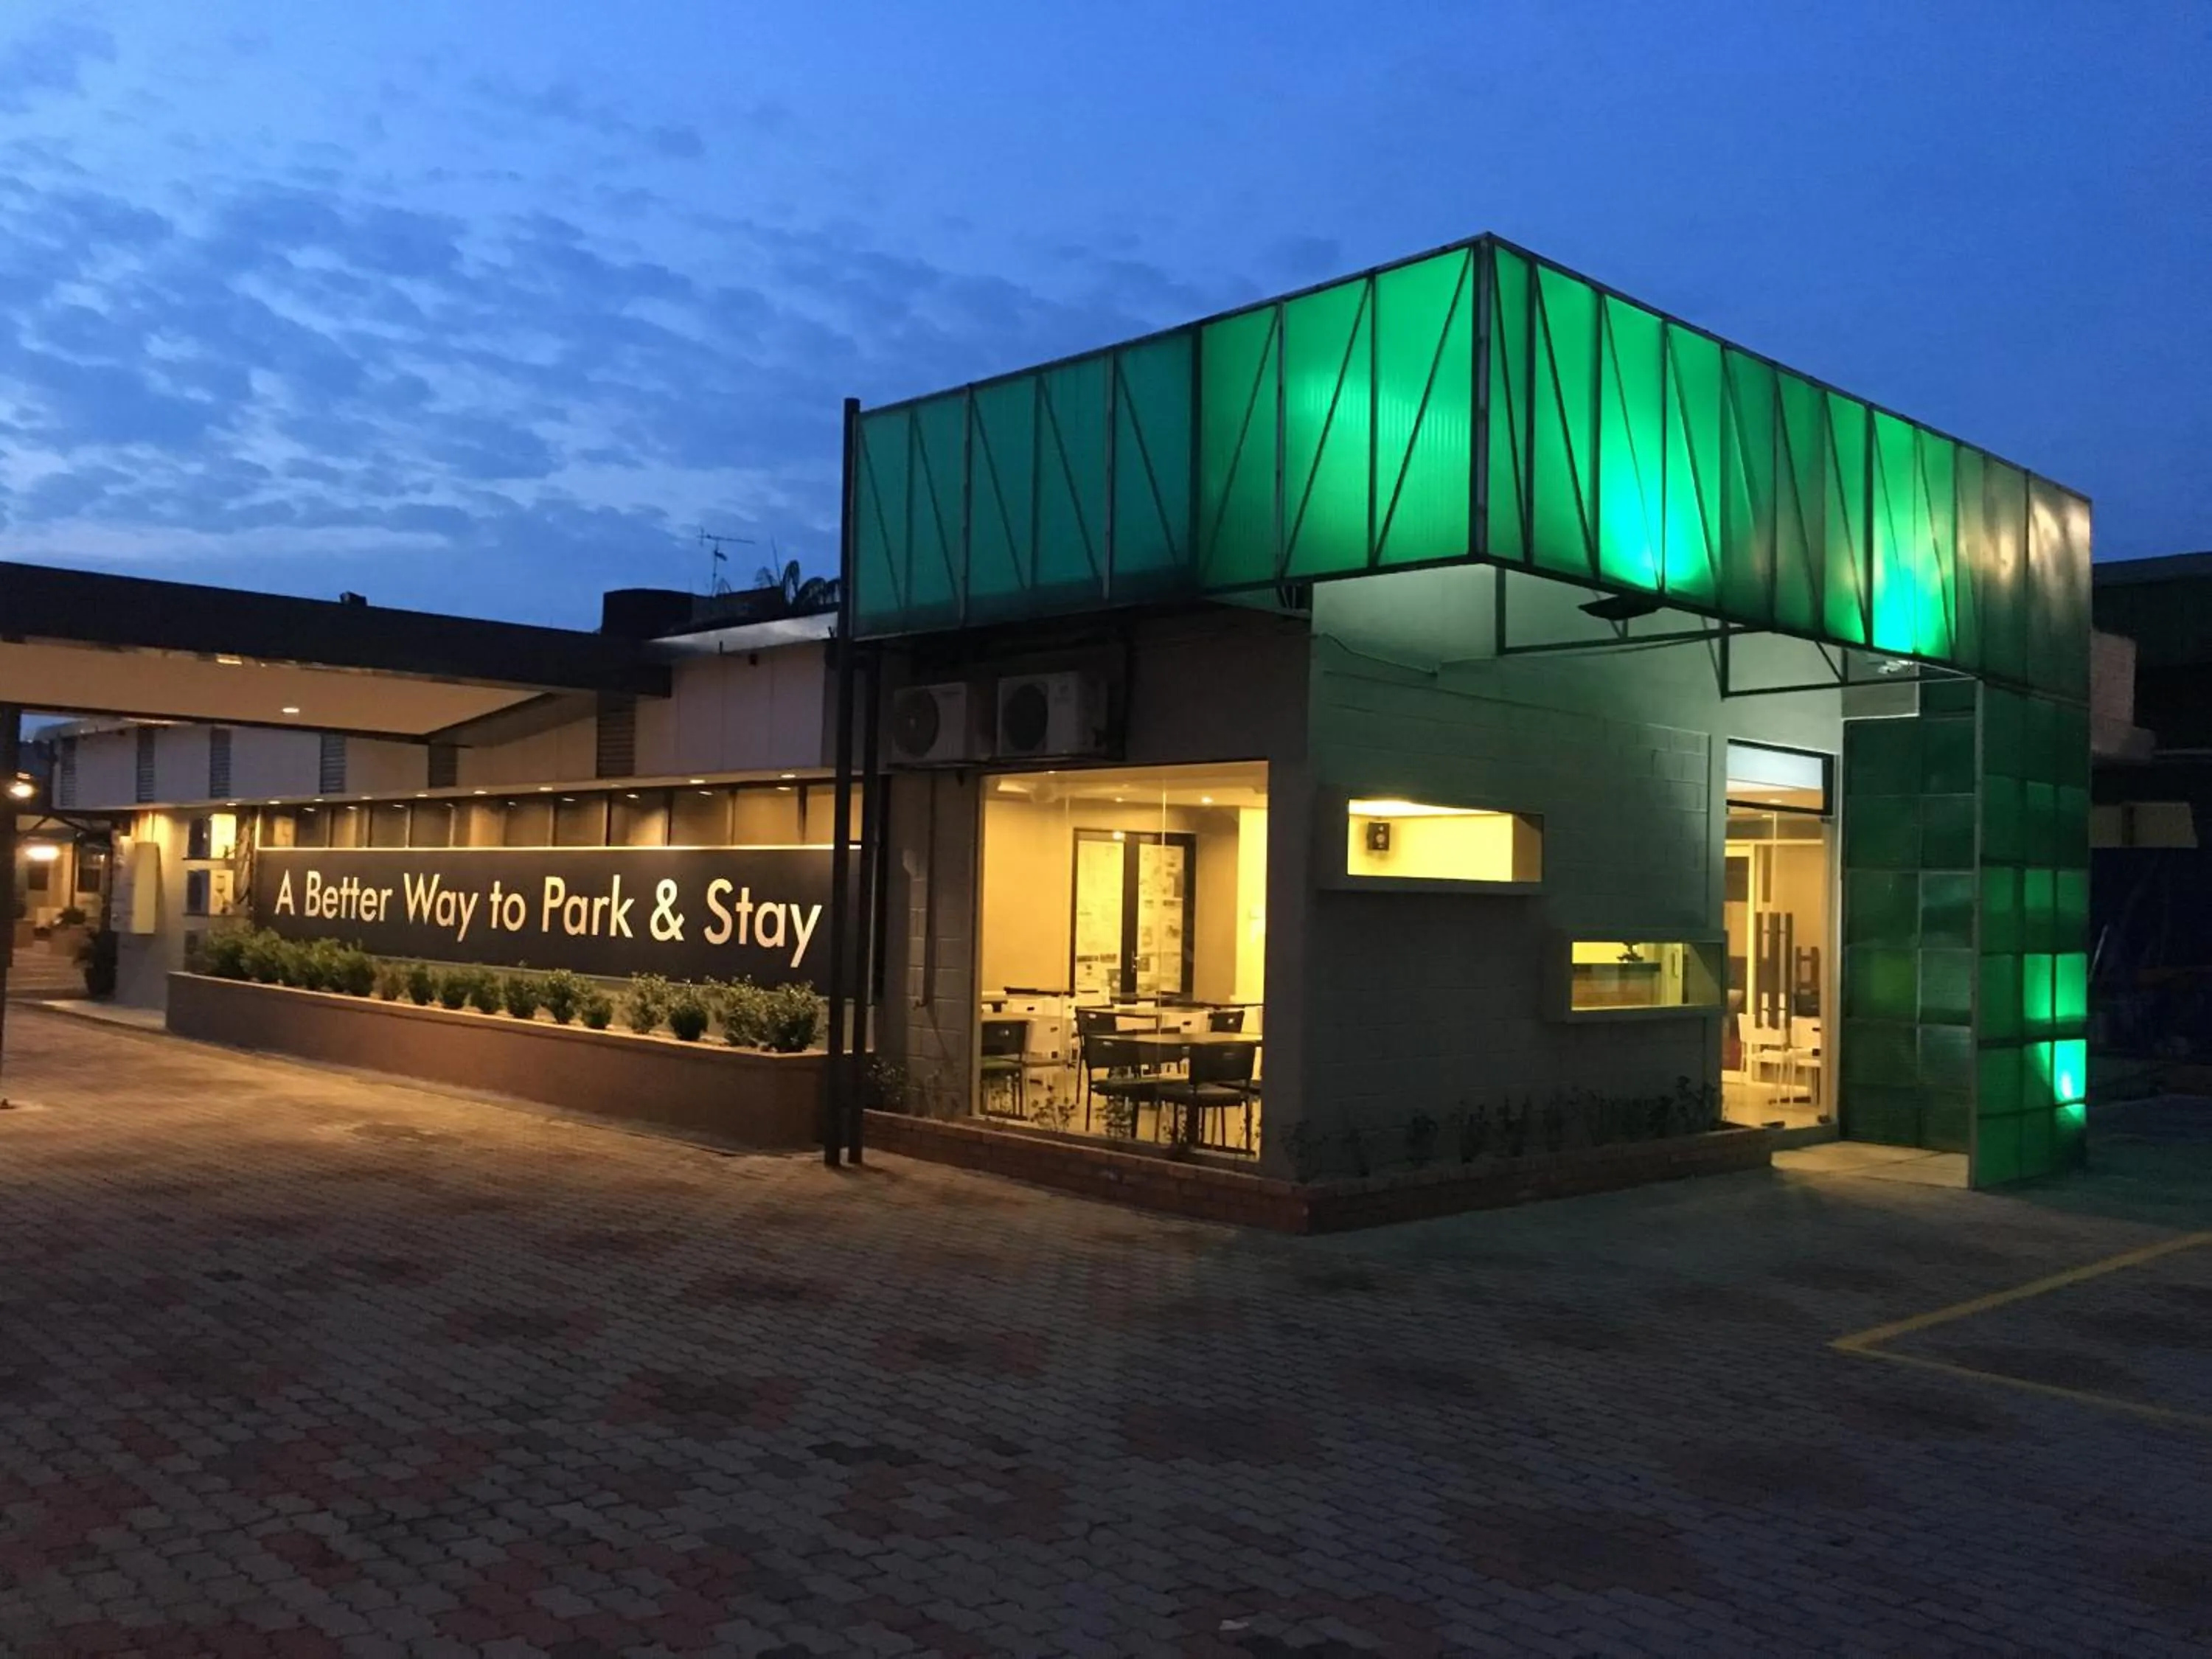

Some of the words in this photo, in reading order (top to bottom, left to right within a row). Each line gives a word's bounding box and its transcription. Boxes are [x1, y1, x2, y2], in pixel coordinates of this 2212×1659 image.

[274, 869, 295, 915] A
[305, 869, 393, 922] Better
[403, 872, 479, 942] Way
[489, 880, 526, 931] to
[541, 874, 634, 939] Park
[650, 878, 685, 942] &
[703, 878, 823, 968] Stay
